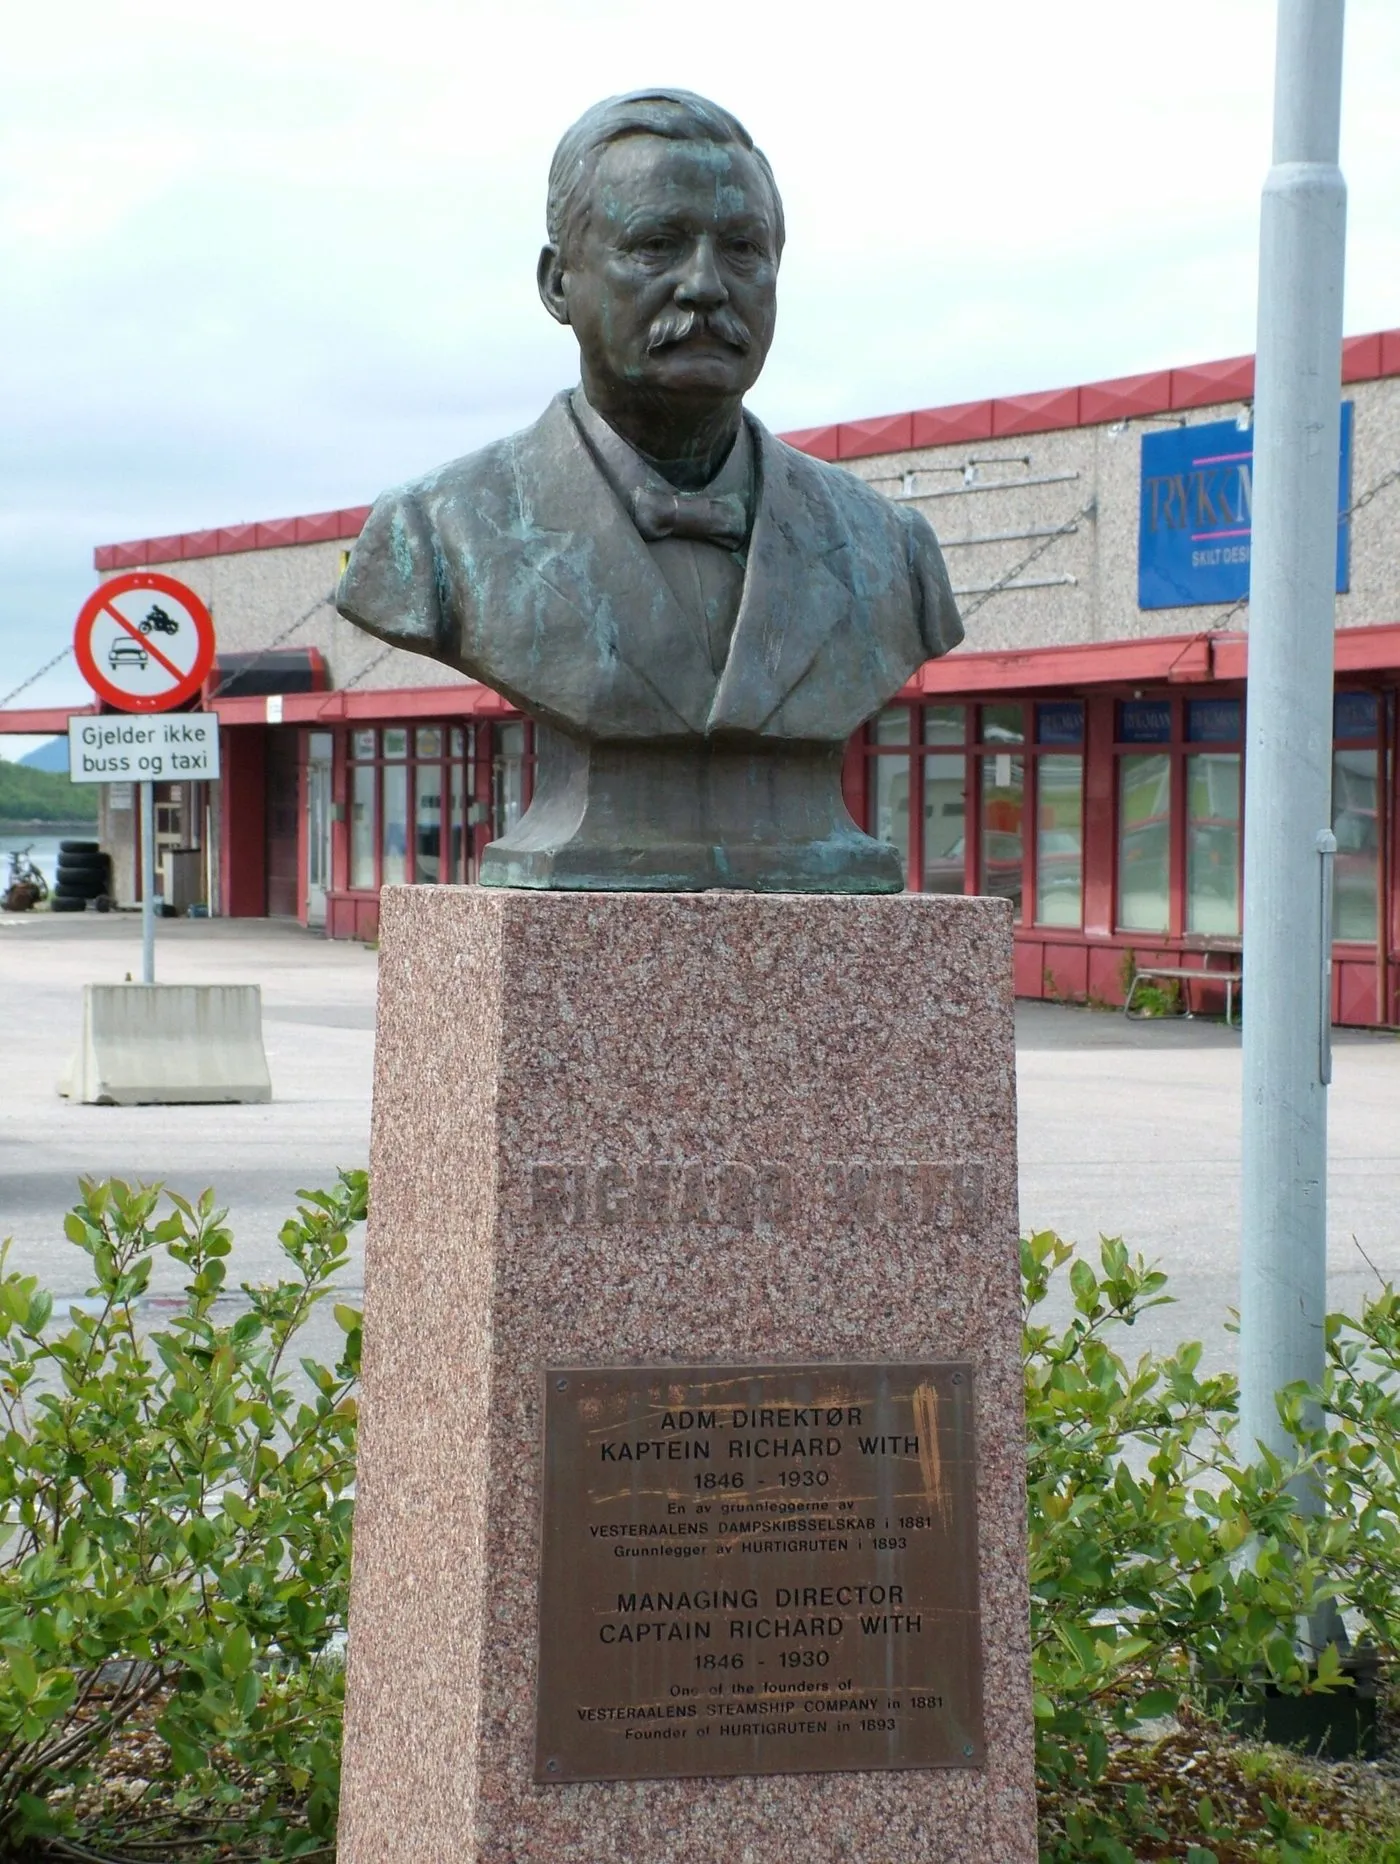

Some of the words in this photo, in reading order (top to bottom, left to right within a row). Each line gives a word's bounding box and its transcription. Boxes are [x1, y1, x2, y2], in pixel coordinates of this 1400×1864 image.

[1192, 550, 1221, 567] SKILT
[82, 726, 155, 749] Gjelder
[163, 725, 206, 743] ikke
[83, 754, 130, 772] buss
[138, 755, 162, 774] og
[171, 751, 207, 769] taxi
[531, 1162, 793, 1227] RICHARD
[822, 1160, 983, 1226] WITH
[661, 1410, 724, 1430] ADM.
[733, 1407, 862, 1428] DIREKTØR
[601, 1440, 710, 1462] KAPTEIN
[729, 1437, 842, 1458] RICHARD
[858, 1435, 919, 1455] WITH
[693, 1472, 744, 1489] 1846
[779, 1470, 829, 1486] 1930
[668, 1503, 685, 1515] En
[696, 1505, 711, 1513] av
[721, 1501, 829, 1515] grunnleggerne
[839, 1502, 854, 1511] av
[590, 1522, 708, 1538] VESTERAALENS
[718, 1518, 875, 1534] DAMPSKIBSSELSKAB
[900, 1516, 931, 1529] 1881
[614, 1543, 706, 1558] Grunnlegger
[716, 1544, 732, 1554] av
[741, 1539, 848, 1553] HURTIGRUTEN
[872, 1538, 906, 1550] 1893
[618, 1589, 758, 1612] MANAGING
[776, 1585, 904, 1607] DIRECTOR
[600, 1622, 710, 1644] CAPTAIN
[730, 1618, 843, 1638] RICHARD
[860, 1616, 921, 1635] WITH
[693, 1653, 744, 1670] 1846
[779, 1651, 829, 1668] 1930
[670, 1684, 699, 1697] One
[709, 1683, 723, 1695] of
[732, 1683, 753, 1694] the
[763, 1681, 829, 1694] founders
[839, 1679, 852, 1692] of
[577, 1704, 697, 1721] VESTERAALENS
[706, 1701, 795, 1717] STEAMSHIP
[804, 1699, 878, 1712] COMPANY
[887, 1699, 900, 1709] in
[911, 1697, 943, 1708] 1881
[625, 1726, 687, 1740] Founder
[697, 1725, 710, 1737] of
[720, 1722, 827, 1736] HURTIGRUTEN
[837, 1721, 849, 1732] in
[860, 1719, 895, 1731] 1893
